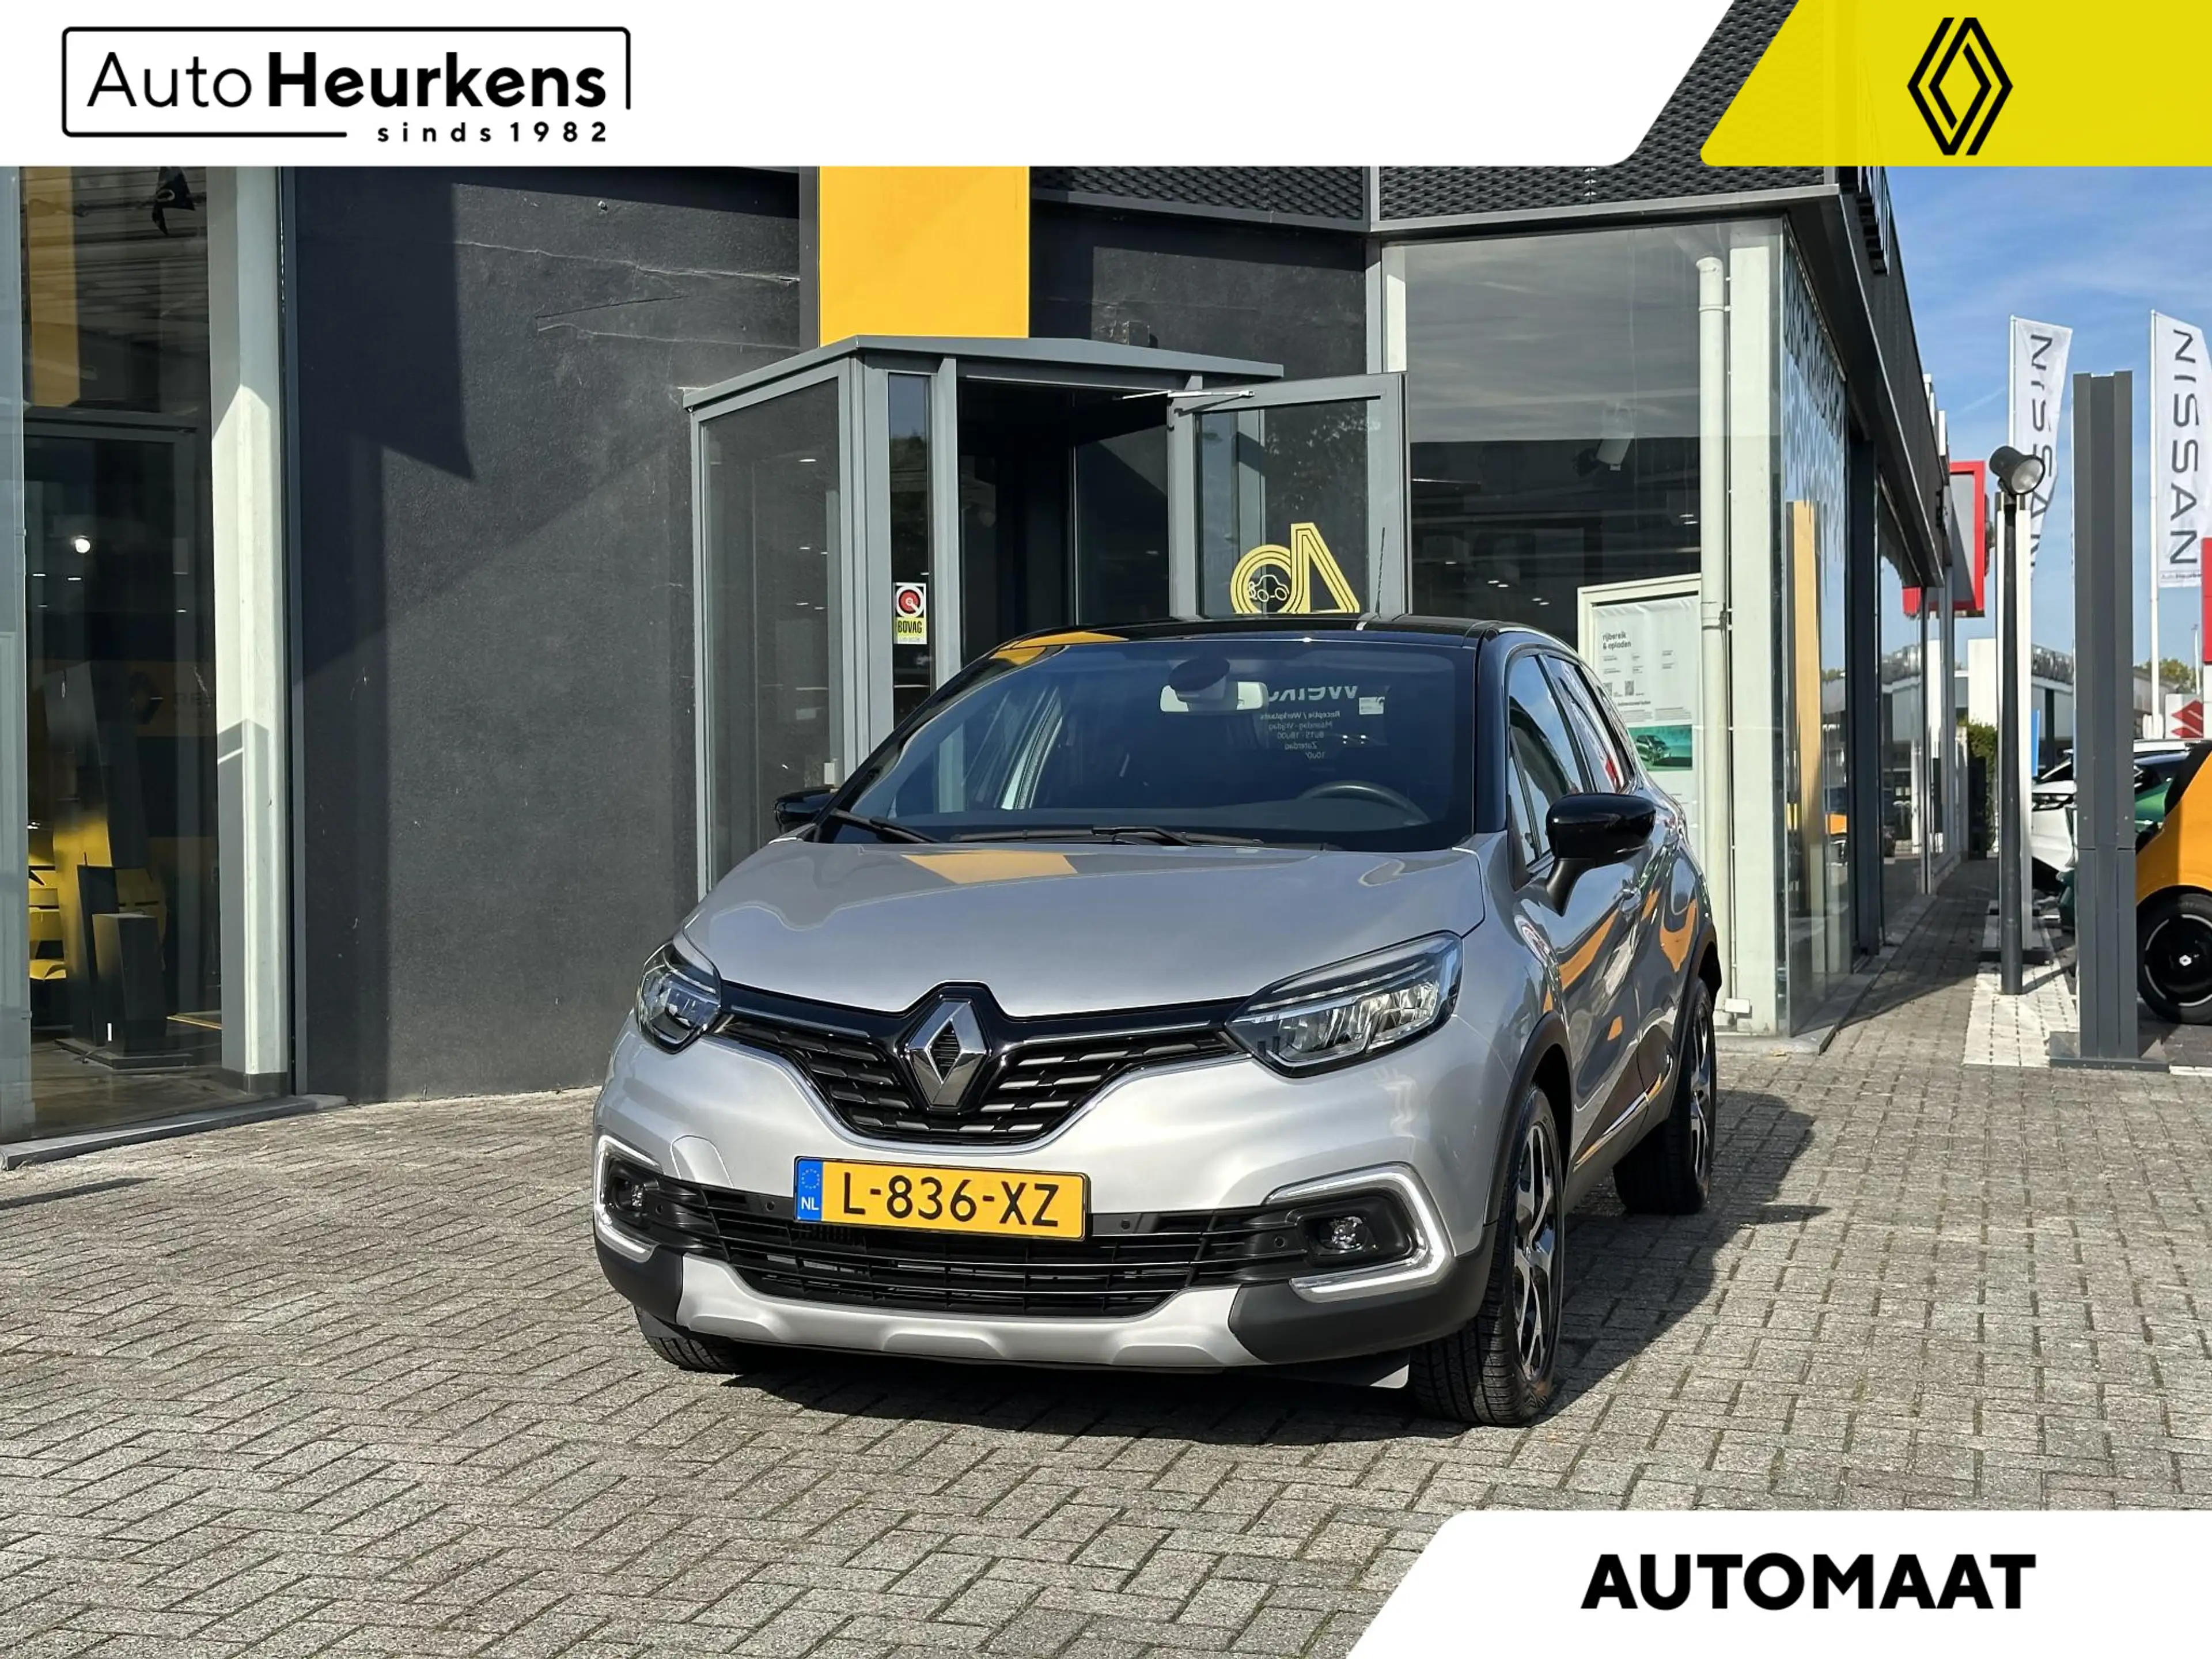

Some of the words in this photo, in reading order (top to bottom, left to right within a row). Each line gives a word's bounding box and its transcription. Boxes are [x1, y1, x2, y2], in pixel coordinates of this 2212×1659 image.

[2169, 328, 2200, 565] NISSAN
[897, 620, 922, 634] BOVAG
[801, 1195, 819, 1211] NL
[843, 1172, 1059, 1228] L-836-XZ
